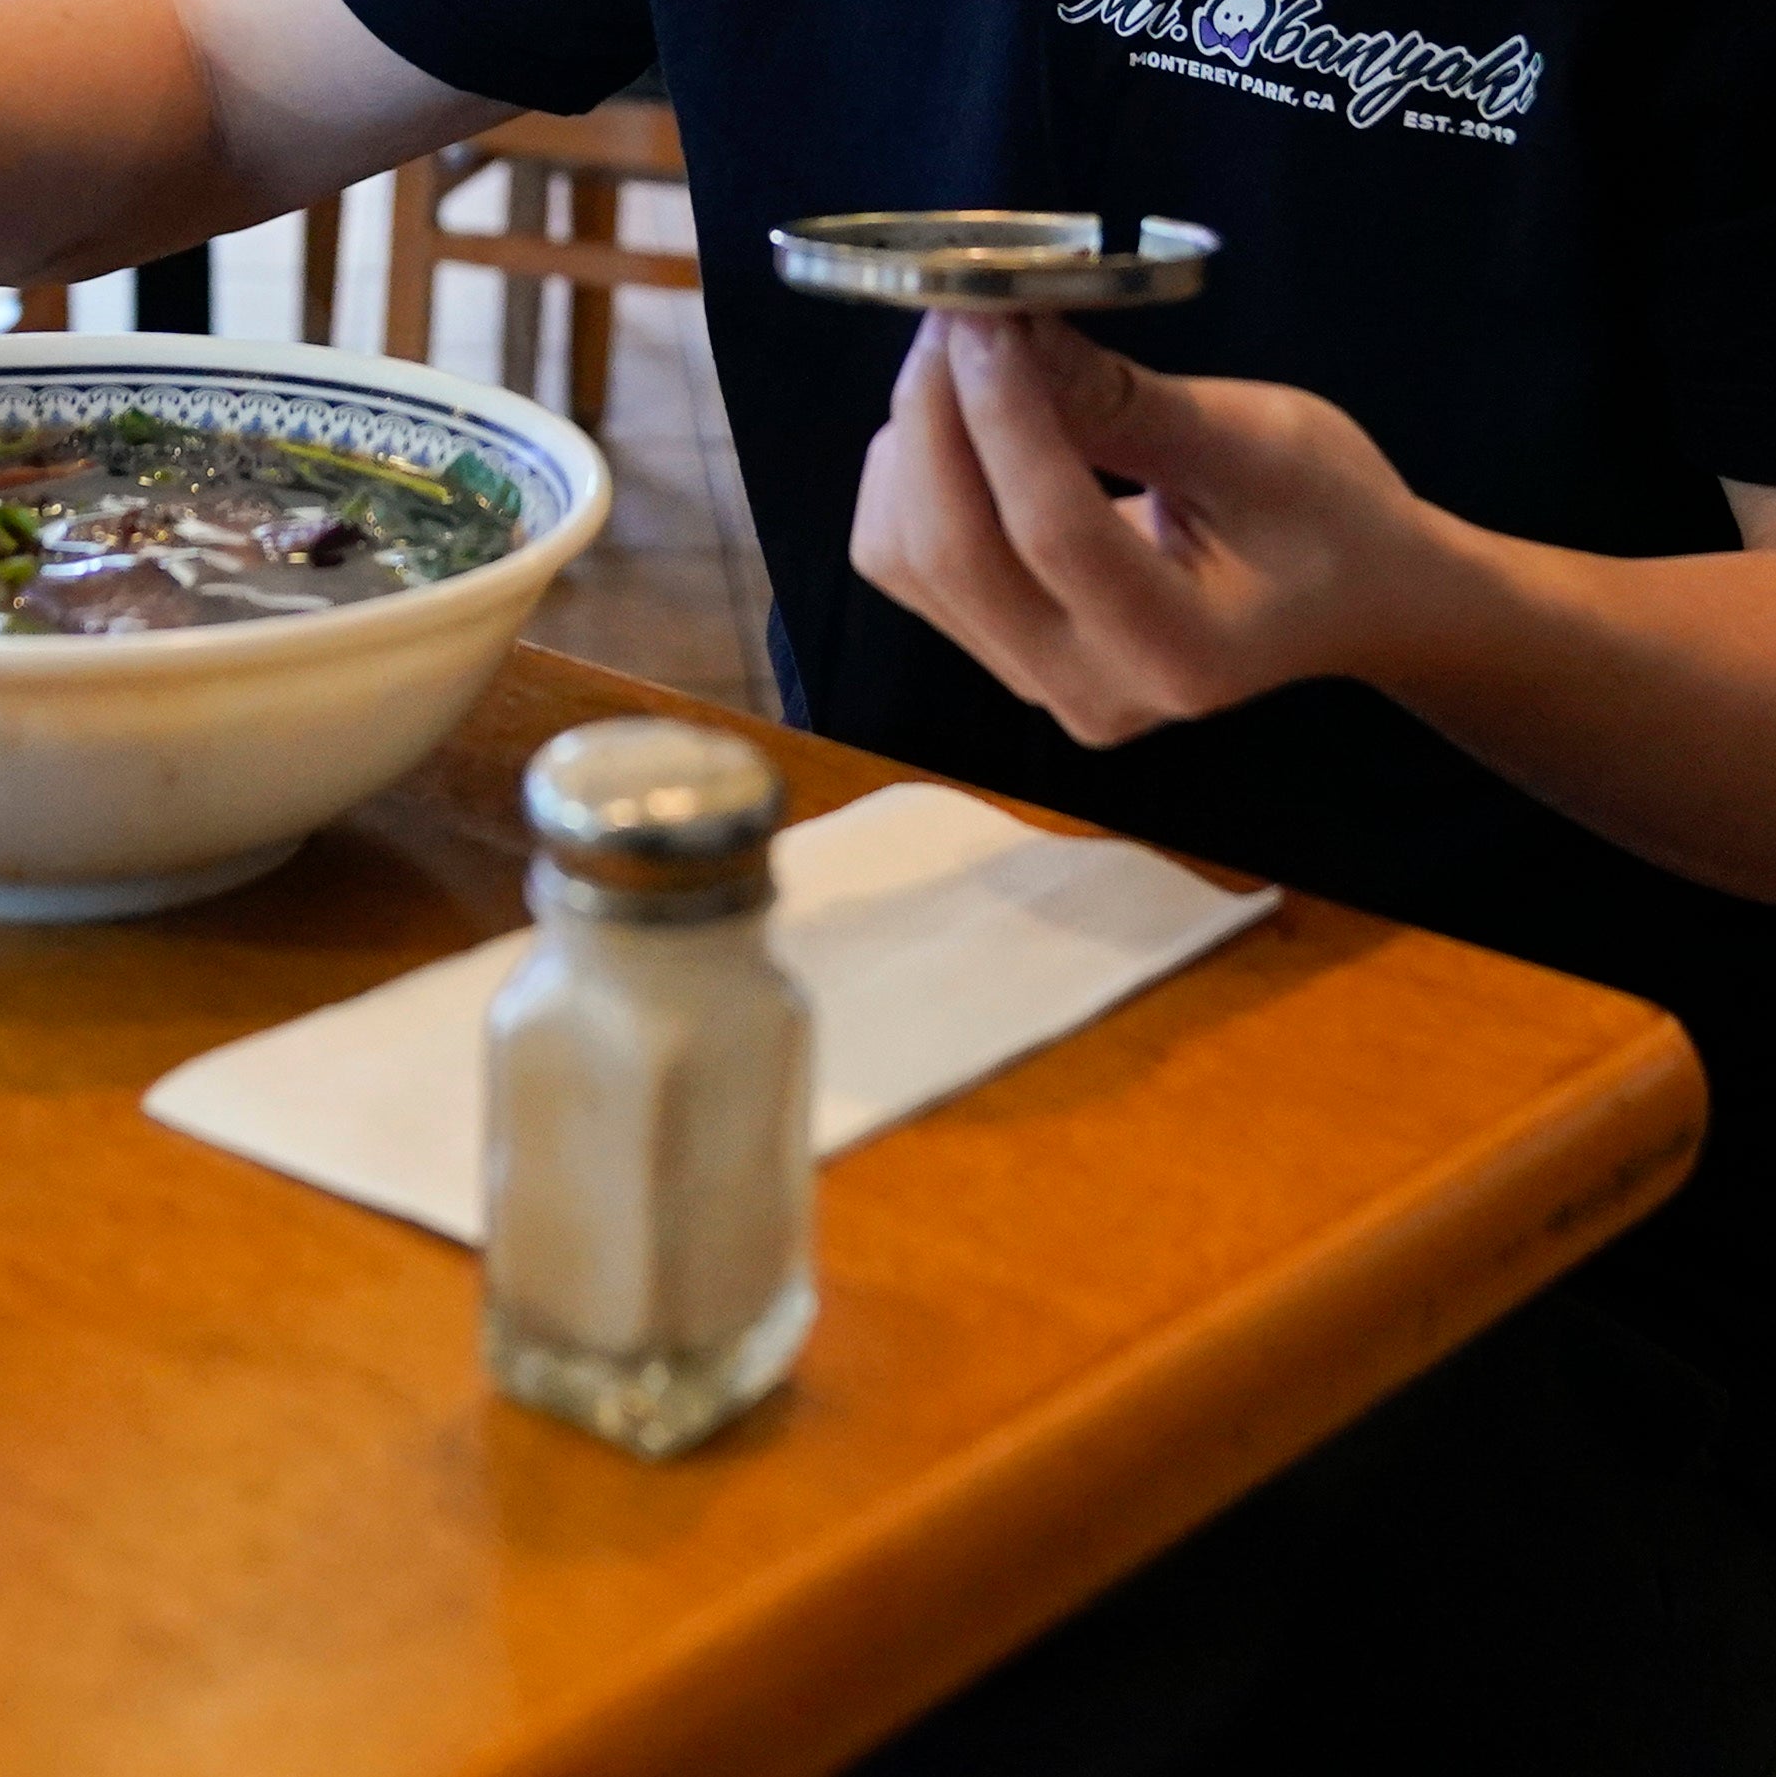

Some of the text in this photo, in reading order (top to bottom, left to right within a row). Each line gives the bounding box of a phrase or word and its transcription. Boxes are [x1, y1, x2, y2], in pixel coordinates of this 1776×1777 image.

[1129, 51, 1336, 112] MONTEREY PARK, CA
[1403, 110, 1518, 145] EST. 2019
